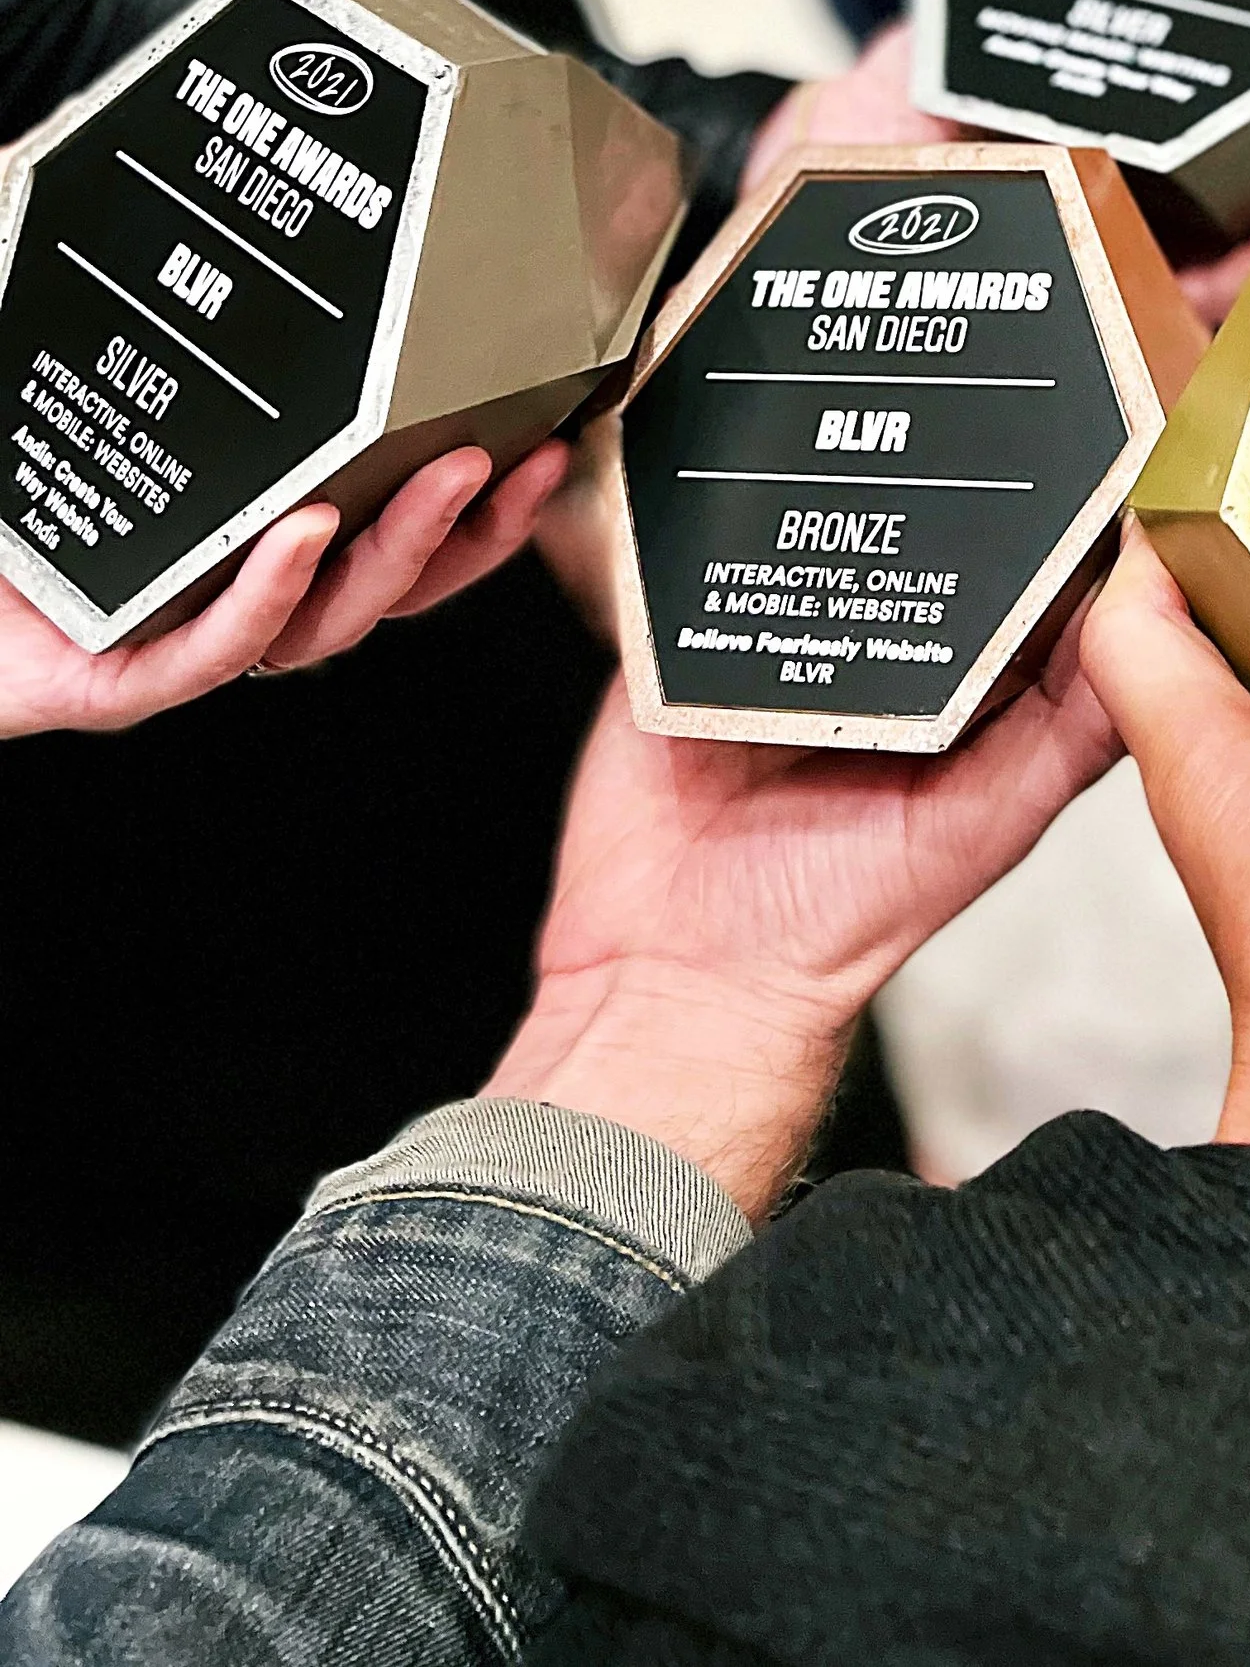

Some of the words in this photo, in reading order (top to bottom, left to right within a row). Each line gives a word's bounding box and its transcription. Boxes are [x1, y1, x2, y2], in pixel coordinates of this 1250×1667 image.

[289, 53, 359, 106] 2021
[176, 58, 236, 122] THE
[223, 93, 287, 157] ONE
[271, 127, 393, 229] AWARDS
[196, 136, 250, 192] SAN
[238, 166, 313, 237] DIEGO
[878, 207, 959, 241] 2021
[158, 243, 232, 320] BLVR
[752, 270, 821, 307] THE
[821, 271, 896, 308] ONE
[895, 272, 1052, 310] AWARDS
[808, 315, 871, 351] SAN
[876, 316, 968, 352] DIEGO
[96, 336, 178, 420] SILVER
[32, 350, 130, 445] INTERACTIVE,
[130, 432, 192, 492] ONLINE
[815, 411, 910, 452] BLVR
[21, 380, 36, 402] &
[33, 390, 94, 451] MOBILE:
[94, 439, 170, 514] WEBSITES
[11, 425, 56, 470] Andis:
[55, 461, 100, 509] Create
[100, 497, 133, 536] Your
[16, 462, 47, 501] Way
[45, 487, 98, 546] Website
[20, 508, 60, 550] Andis
[777, 511, 906, 554] BRONZE
[704, 562, 859, 593] INTERACTIVE,
[867, 570, 958, 594] ONLINE
[704, 591, 721, 612] &
[725, 592, 821, 617] MOBILE:
[828, 597, 944, 624] WEBSITES
[678, 628, 752, 651] Believe
[756, 632, 861, 662] Fearlessly
[867, 638, 953, 663] Website
[780, 661, 834, 684] BLVR
